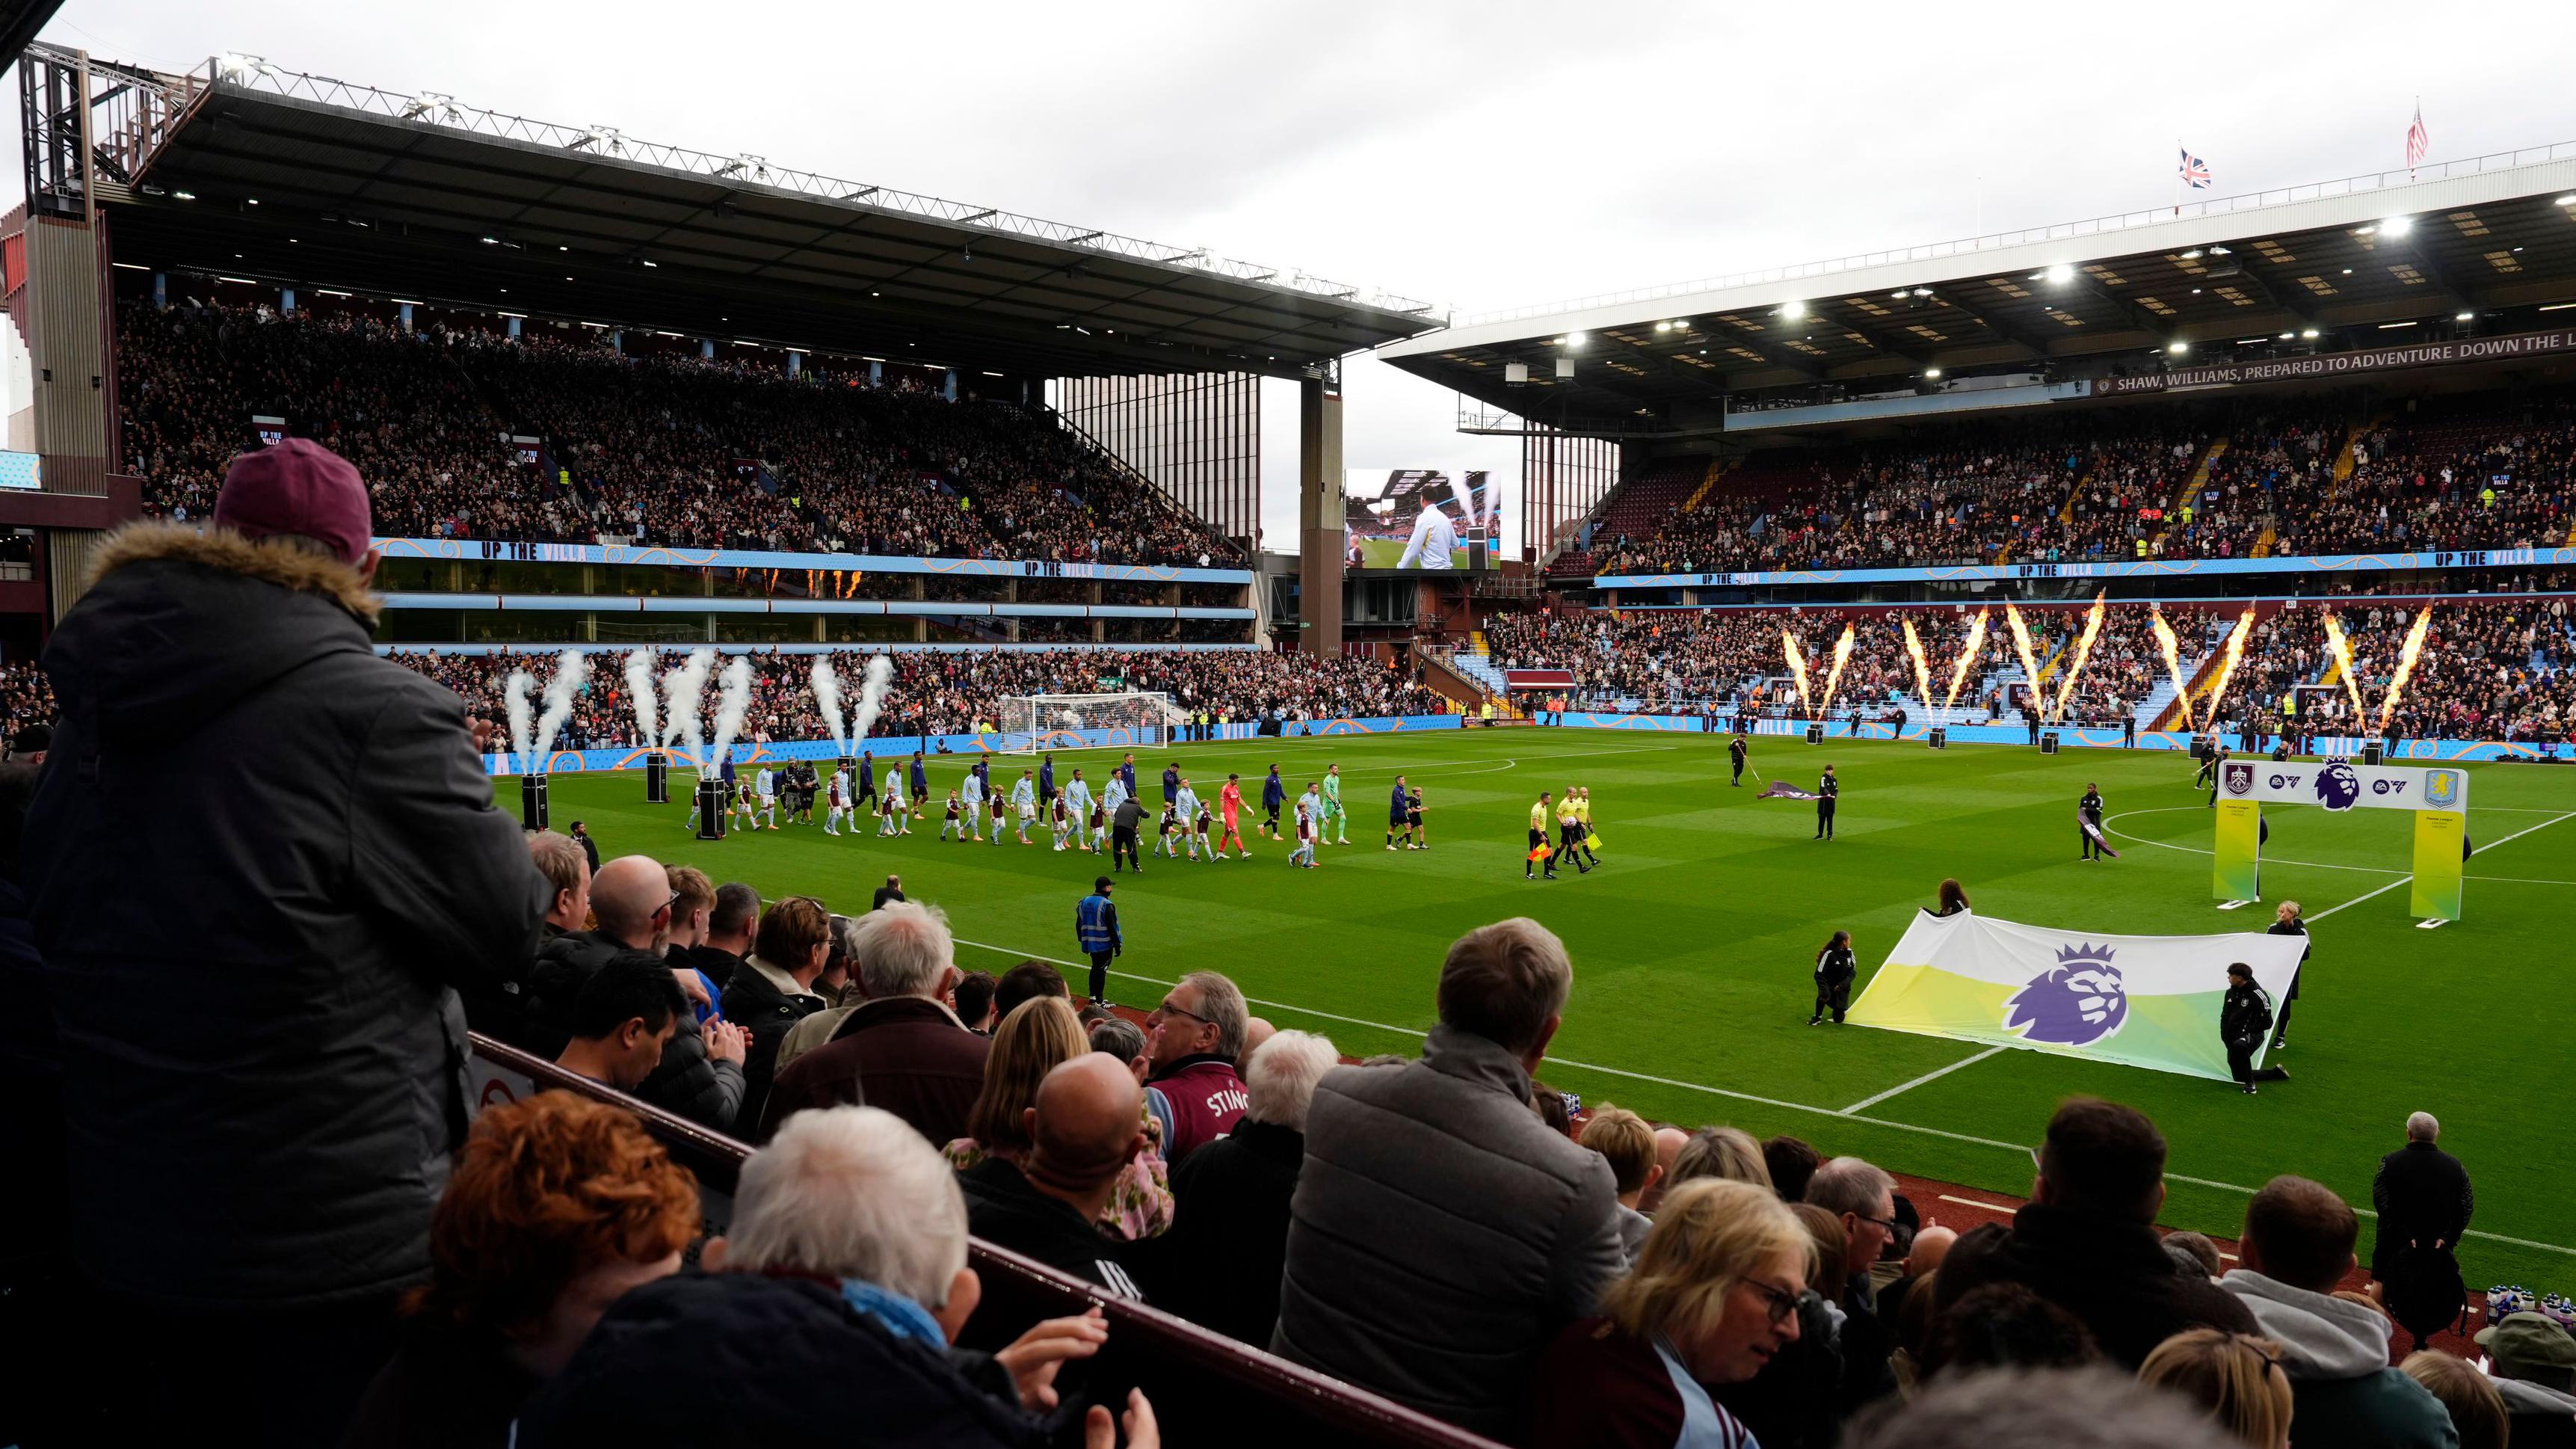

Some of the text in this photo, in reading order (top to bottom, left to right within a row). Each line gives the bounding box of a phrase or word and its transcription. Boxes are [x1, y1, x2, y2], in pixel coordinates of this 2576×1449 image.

[2117, 375, 2163, 391] SHAW,
[2166, 369, 2241, 386] WILLIAMS,
[2245, 360, 2323, 379] PREPARED
[2326, 357, 2348, 371] TO
[2351, 346, 2453, 369] ADVENTURE
[2459, 339, 2519, 357] DOWN
[2523, 334, 2560, 351] THE
[270, 431, 282, 440] THE
[481, 541, 587, 562] UP THE VILLA
[2435, 550, 2535, 566] UP THE VILLA
[1025, 562, 1094, 579] UP THE VILLA
[2020, 564, 2092, 576] UP THE VILLA
[1702, 574, 1713, 585] UP
[1716, 573, 1731, 584] THE
[1184, 724, 1214, 742] THE
[1702, 714, 1793, 735] UP THE VILLA
